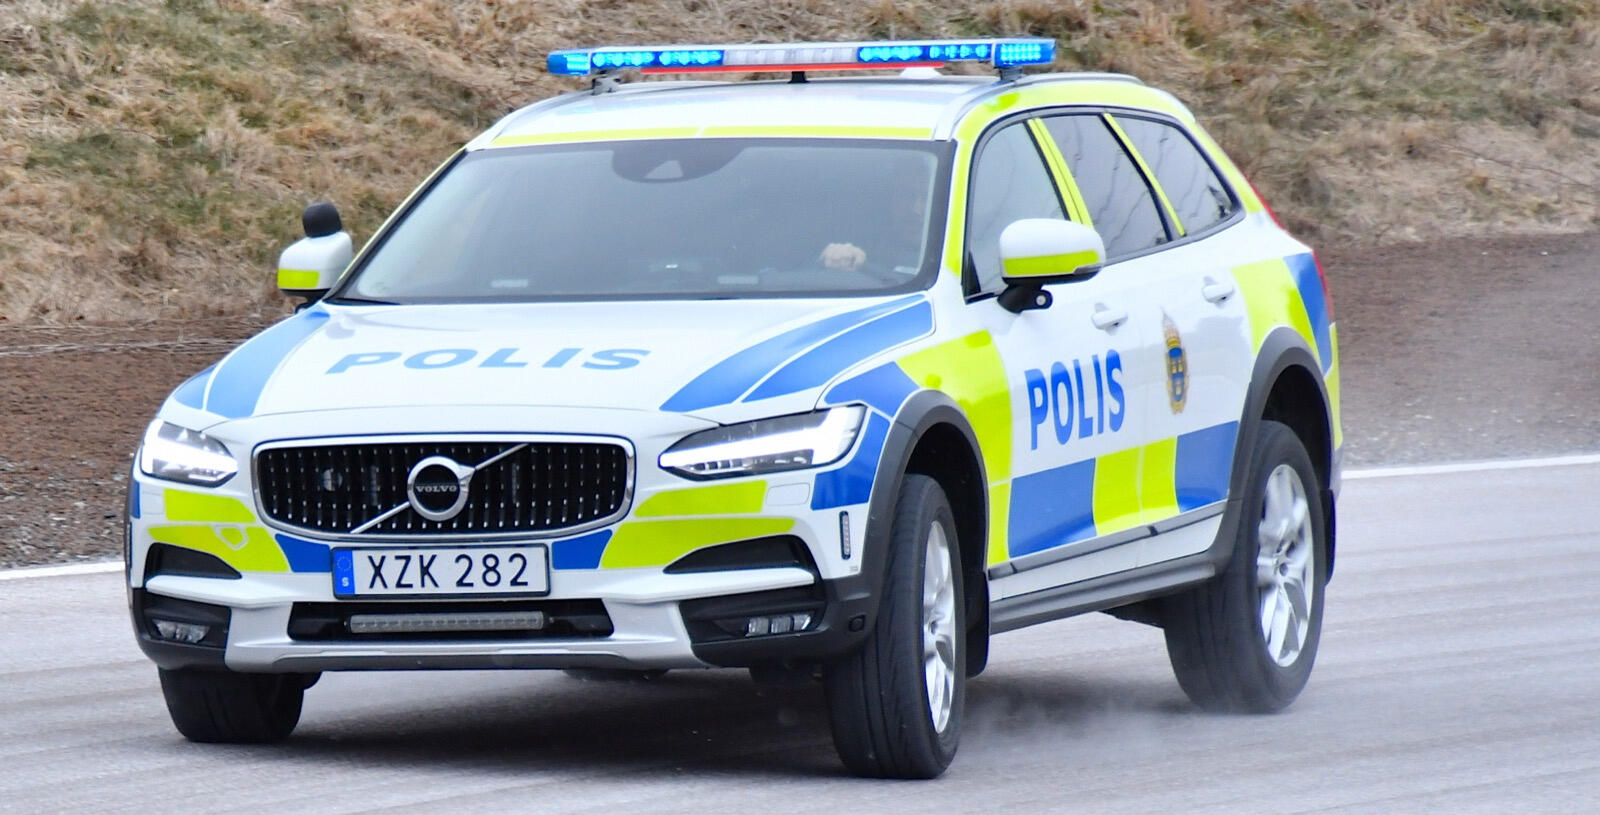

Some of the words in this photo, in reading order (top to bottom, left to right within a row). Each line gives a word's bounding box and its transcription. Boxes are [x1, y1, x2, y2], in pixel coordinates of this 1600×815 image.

[325, 348, 651, 374] POLIS
[1024, 349, 1125, 450] POLIS
[416, 485, 457, 493] VOLVO
[342, 577, 349, 587] S
[368, 554, 439, 589] XZK
[455, 553, 528, 587] 282
